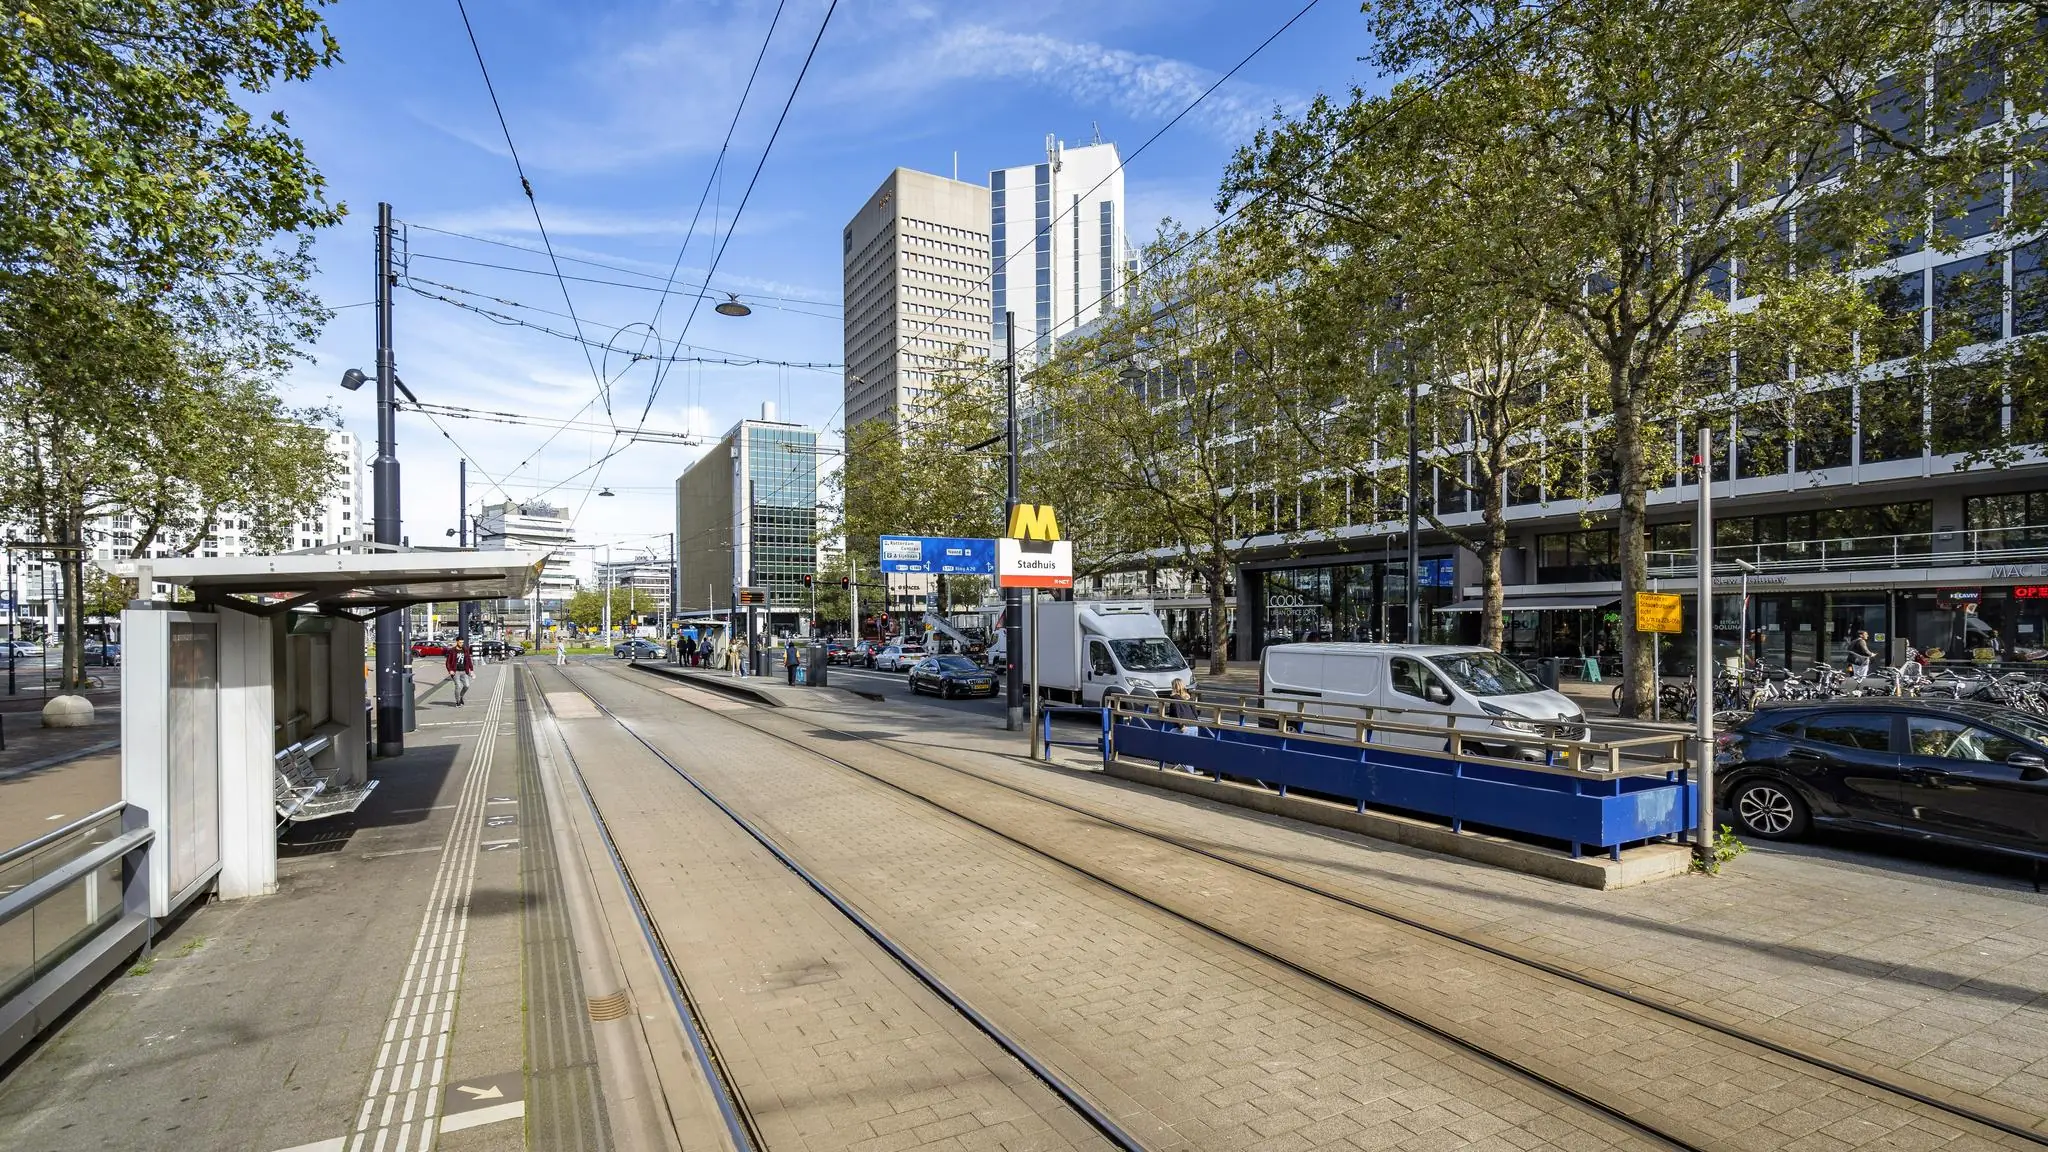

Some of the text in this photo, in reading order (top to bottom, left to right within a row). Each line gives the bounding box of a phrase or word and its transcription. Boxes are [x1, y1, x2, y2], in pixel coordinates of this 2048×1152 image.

[1008, 503, 1060, 541] M
[1017, 560, 1056, 569] Stadhuis
[1989, 565, 2033, 578] MAC
[1712, 577, 1737, 585] New
[1270, 594, 1304, 607] COOLS
